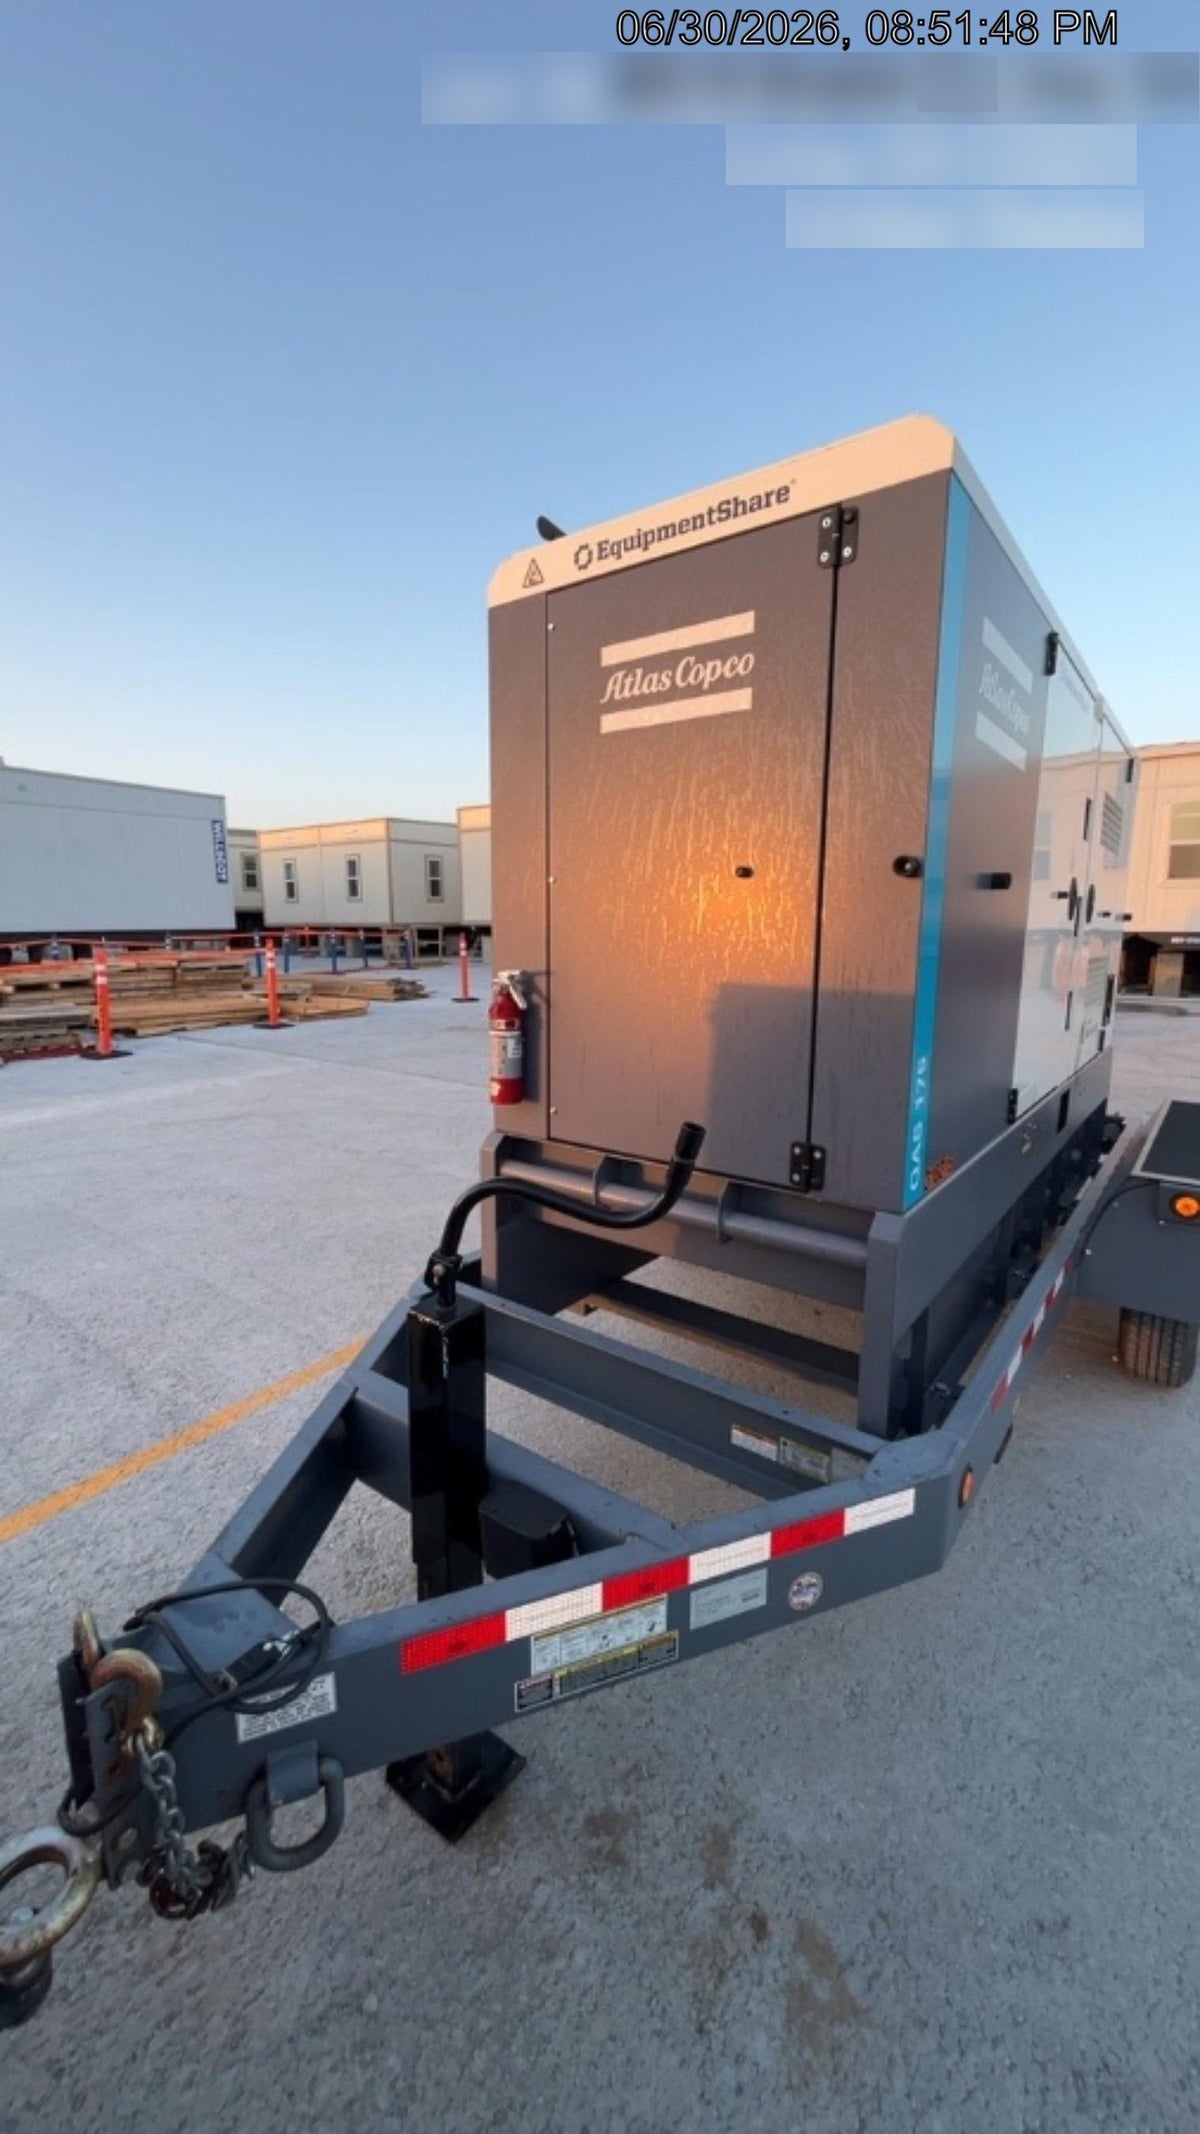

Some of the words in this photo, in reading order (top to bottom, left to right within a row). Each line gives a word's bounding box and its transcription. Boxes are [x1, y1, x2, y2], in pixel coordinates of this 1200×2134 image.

[596, 484, 790, 561] EquipmentShare
[601, 668, 672, 704] Atlas
[675, 653, 755, 691] Copco
